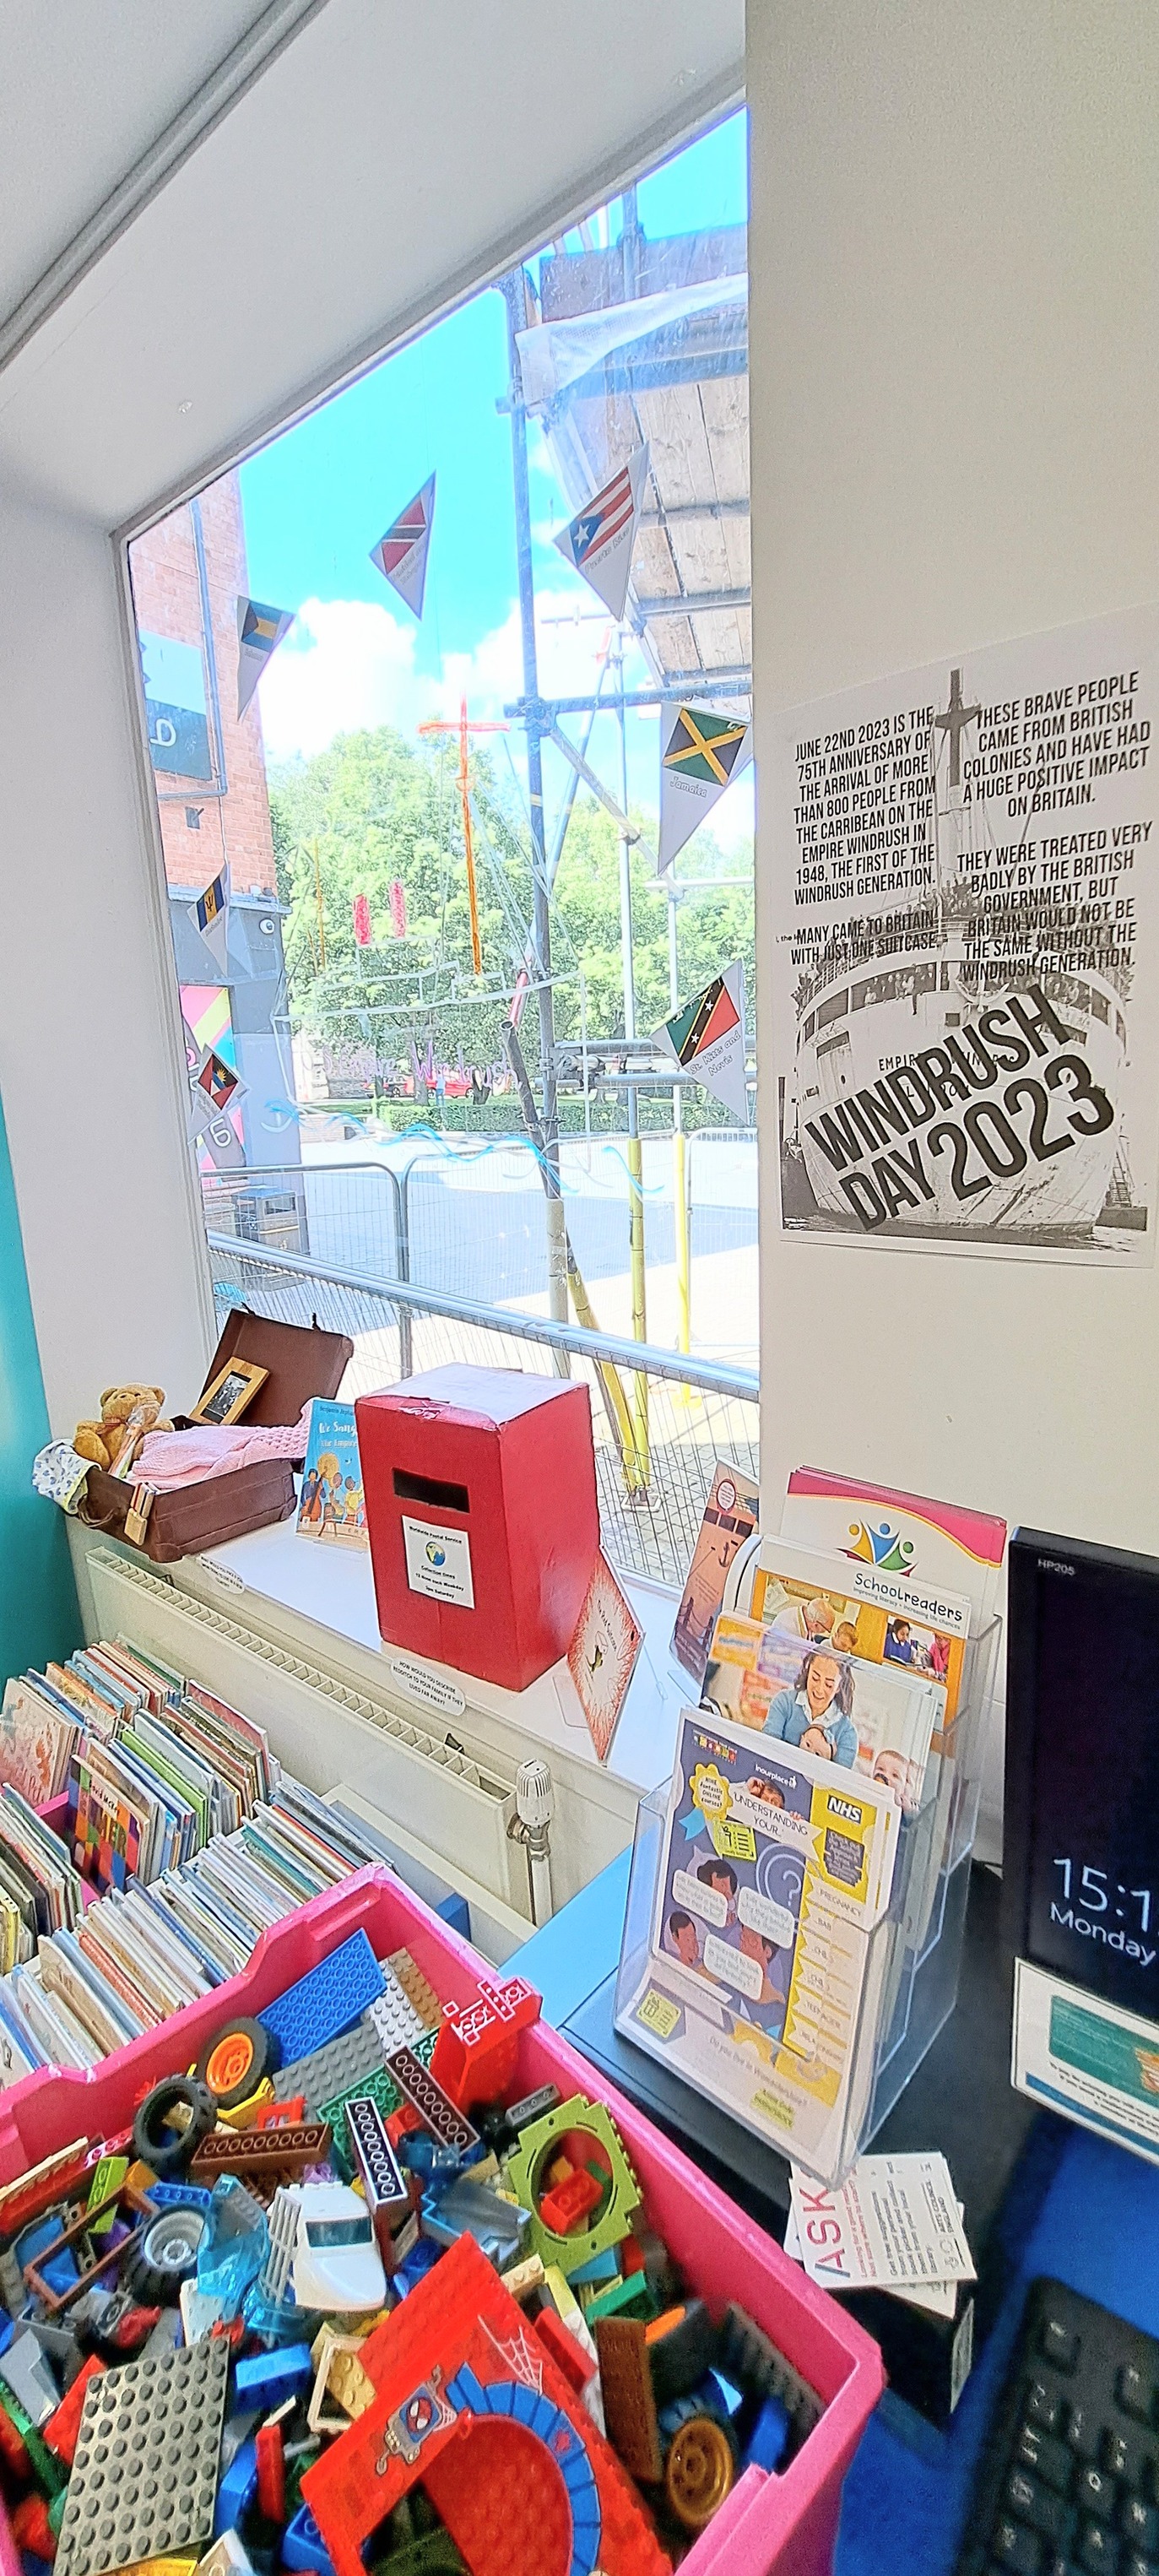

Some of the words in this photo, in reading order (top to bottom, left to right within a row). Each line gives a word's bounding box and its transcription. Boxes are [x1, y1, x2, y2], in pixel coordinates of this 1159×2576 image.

[978, 701, 1020, 729] THESE
[1025, 687, 1074, 717] BRAVE
[1078, 671, 1139, 704] PEOPLE
[795, 738, 821, 762] JUNE
[825, 729, 854, 753] 22ND
[858, 719, 889, 744] 2023
[894, 714, 905, 734] IS
[909, 706, 933, 729] THE
[979, 725, 1019, 752] CAME
[1023, 714, 1065, 742] FROM
[1070, 699, 1133, 731] BRITISH
[798, 758, 826, 782] 75TH
[830, 735, 911, 773] ANNIVERSARY
[915, 729, 930, 751] OF
[963, 747, 1032, 779] COLONIES
[1036, 739, 1067, 764] AND
[1072, 729, 1113, 757] HAVE
[1117, 721, 1151, 747] HAD
[669, 776, 707, 798] Jamaica
[800, 782, 821, 802] THE
[824, 769, 871, 797] ARRIVAL
[875, 764, 889, 784] OF
[893, 754, 929, 779] MORE
[963, 784, 972, 802] A
[977, 775, 1013, 800] HUGE
[1018, 760, 1085, 792] POSITIVE
[1089, 746, 1150, 778] IMPACT
[793, 805, 823, 824] THAN
[827, 797, 848, 816] 800
[853, 784, 896, 811] PEOPLE
[900, 775, 935, 800] FROM
[796, 825, 817, 843] THE
[821, 810, 885, 839] CARRIBEAN
[889, 805, 905, 824] ON
[909, 799, 933, 820] THE
[1008, 795, 1027, 817] ON
[1032, 784, 1096, 813] BRITAIN.
[796, 865, 828, 885] 1948,
[831, 860, 853, 879] THE
[856, 853, 888, 875] FIRST
[892, 849, 907, 868] OF
[911, 843, 934, 864] THE
[803, 840, 843, 864] EMPIRE
[847, 826, 909, 854] WINDRUSH
[914, 823, 926, 841] IN
[957, 849, 992, 872] THEY
[996, 842, 1037, 865] WERE
[1041, 829, 1107, 858] TREATED
[1113, 821, 1153, 847] VERY
[795, 880, 853, 905] WINDRUSH
[857, 866, 935, 896] GENERATION.
[972, 868, 1014, 893] BADLY
[1018, 865, 1037, 886] BY
[1041, 860, 1069, 882] THE
[1074, 849, 1135, 877] BRITISH
[983, 882, 1084, 914] GOVERNMENT,
[1089, 876, 1118, 898] BUT
[797, 925, 828, 945] MANY
[832, 918, 864, 940] CAME
[869, 917, 881, 935] TO
[968, 914, 1020, 938] BRITAIN
[1026, 907, 1076, 930] WOULD
[1080, 902, 1112, 923] NOT
[1116, 898, 1135, 919] BE
[791, 947, 820, 965] WITH
[823, 942, 848, 962] JUST
[853, 939, 875, 957] ONE
[879, 932, 940, 957] SUITCASE.
[965, 941, 990, 959] THE
[994, 935, 1032, 957] SAME
[1037, 925, 1103, 952] WITHOUT
[1109, 922, 1137, 943] THE
[963, 957, 1036, 982] WINDRUSH
[1040, 946, 1135, 974] GENERATION.
[690, 1059, 703, 1075] St.
[702, 1044, 724, 1066] Kitts
[724, 1030, 741, 1049] and
[708, 1055, 734, 1077] Nevis
[879, 1054, 916, 1071] EMPIR
[805, 984, 1072, 1172] WINDRUSH
[839, 1139, 935, 1231] DAY
[928, 1055, 1114, 1201] 2023
[333, 1421, 357, 1437] Sang
[445, 1536, 462, 1544] Service
[1037, 1558, 1076, 1575] HP205
[855, 1573, 962, 1621] Schoolreaders
[829, 1798, 861, 1822] NHS
[1053, 1858, 1159, 1932] 15:1
[1050, 1901, 1156, 1966] Monday
[799, 2188, 850, 2278] ASK
